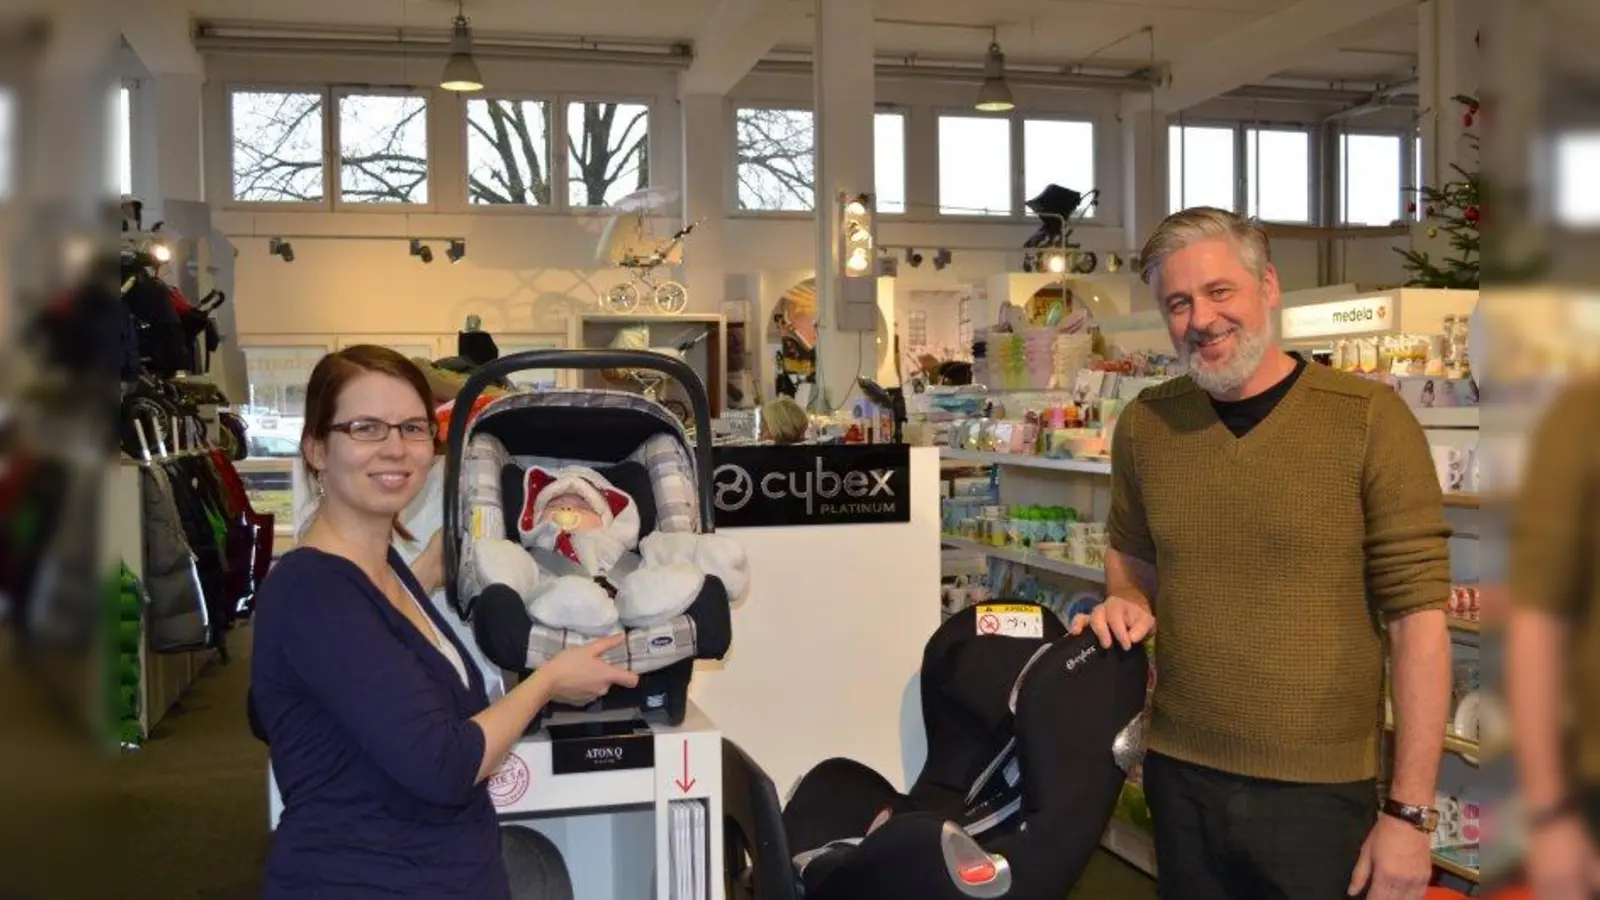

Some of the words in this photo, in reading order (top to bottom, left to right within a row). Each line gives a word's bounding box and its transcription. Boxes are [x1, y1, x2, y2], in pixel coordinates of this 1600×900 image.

[1332, 307, 1373, 324] medela
[761, 456, 896, 515] cybex
[820, 502, 896, 515] PLATINUM
